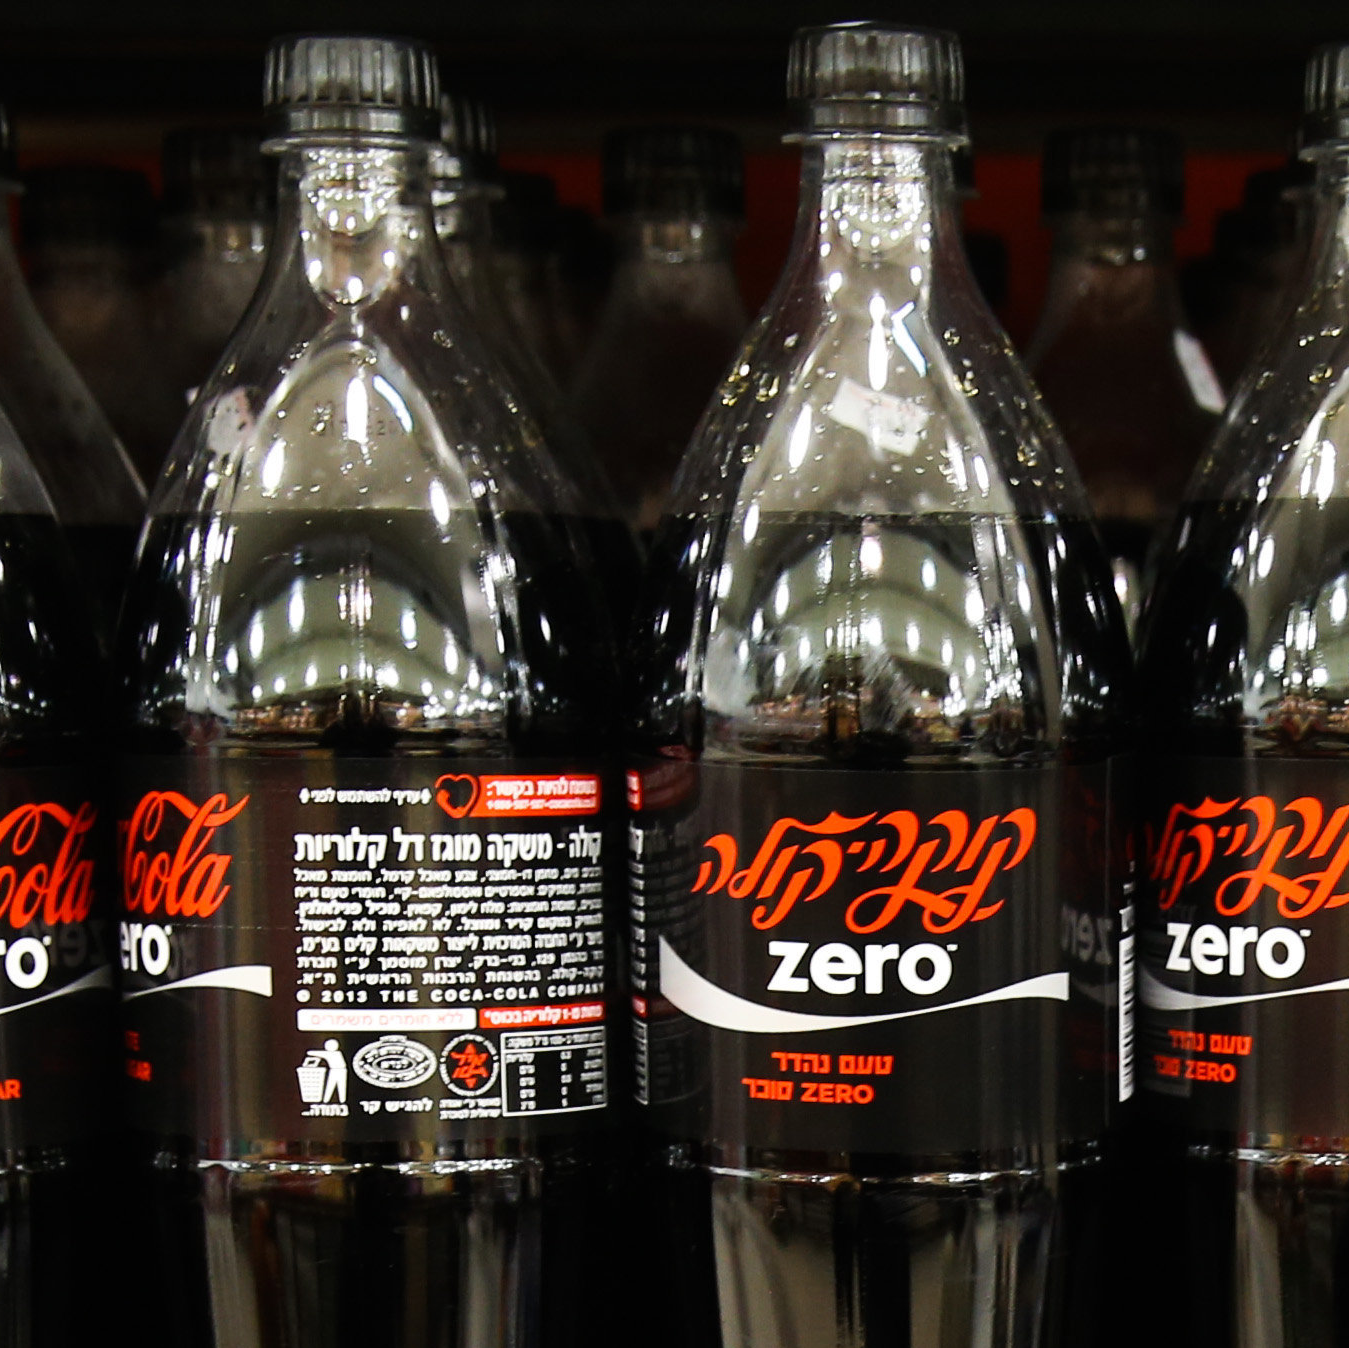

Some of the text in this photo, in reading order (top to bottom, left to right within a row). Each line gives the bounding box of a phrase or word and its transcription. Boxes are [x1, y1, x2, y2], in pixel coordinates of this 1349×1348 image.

[294, 827, 387, 868] קלוריות
[393, 827, 425, 861] דל
[430, 834, 481, 861] מוגז
[487, 834, 552, 867] משקה
[1165, 921, 1308, 980] zero
[766, 940, 953, 996] zero
[322, 990, 367, 1002] 2013
[380, 990, 418, 1002] THE
[431, 987, 538, 1002] COCA-COLA
[770, 1050, 895, 1076] טעם נהדר
[1184, 1060, 1238, 1084] ZERO
[741, 1077, 875, 1104] ZERO סוכר
